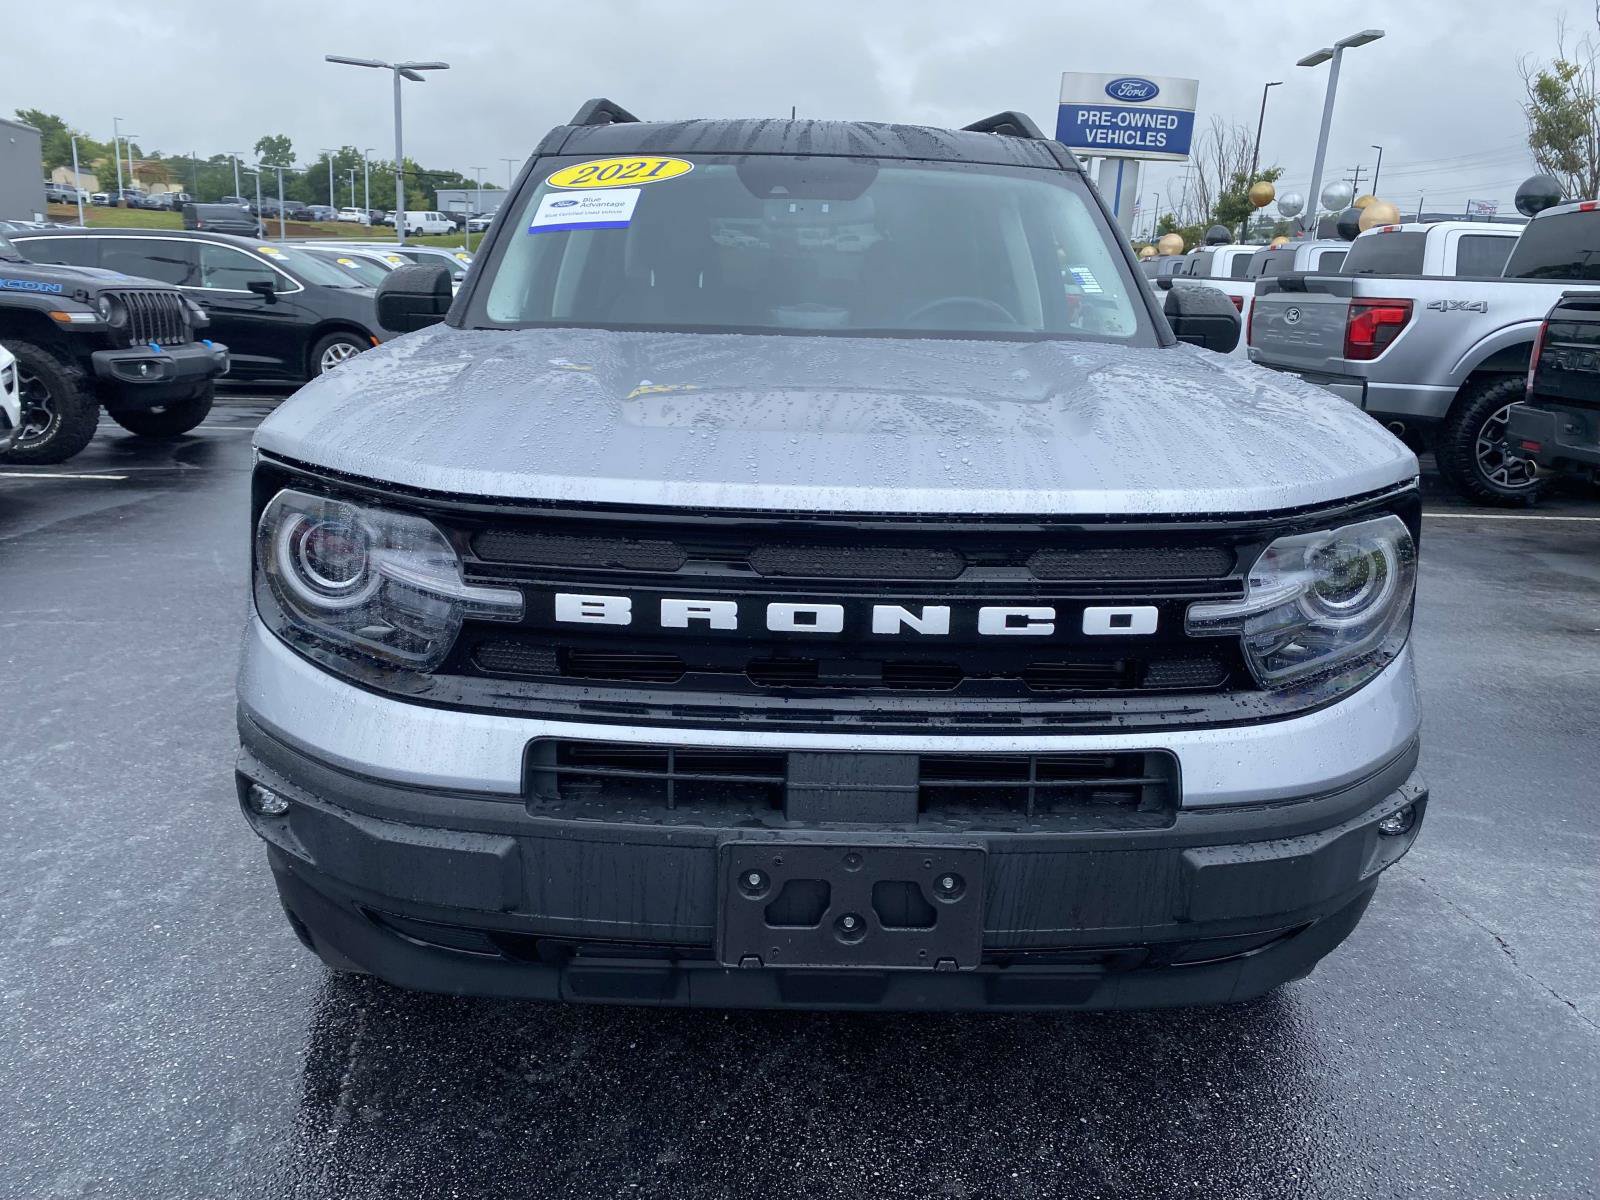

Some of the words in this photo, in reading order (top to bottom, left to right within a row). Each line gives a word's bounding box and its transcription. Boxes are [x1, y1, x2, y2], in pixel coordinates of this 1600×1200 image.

[1117, 82, 1148, 97] Ford
[1077, 110, 1179, 130] PRE-OWNED
[1086, 129, 1167, 147] VEHICLES
[568, 160, 670, 185] 2021
[555, 593, 1159, 636] BRONCO
